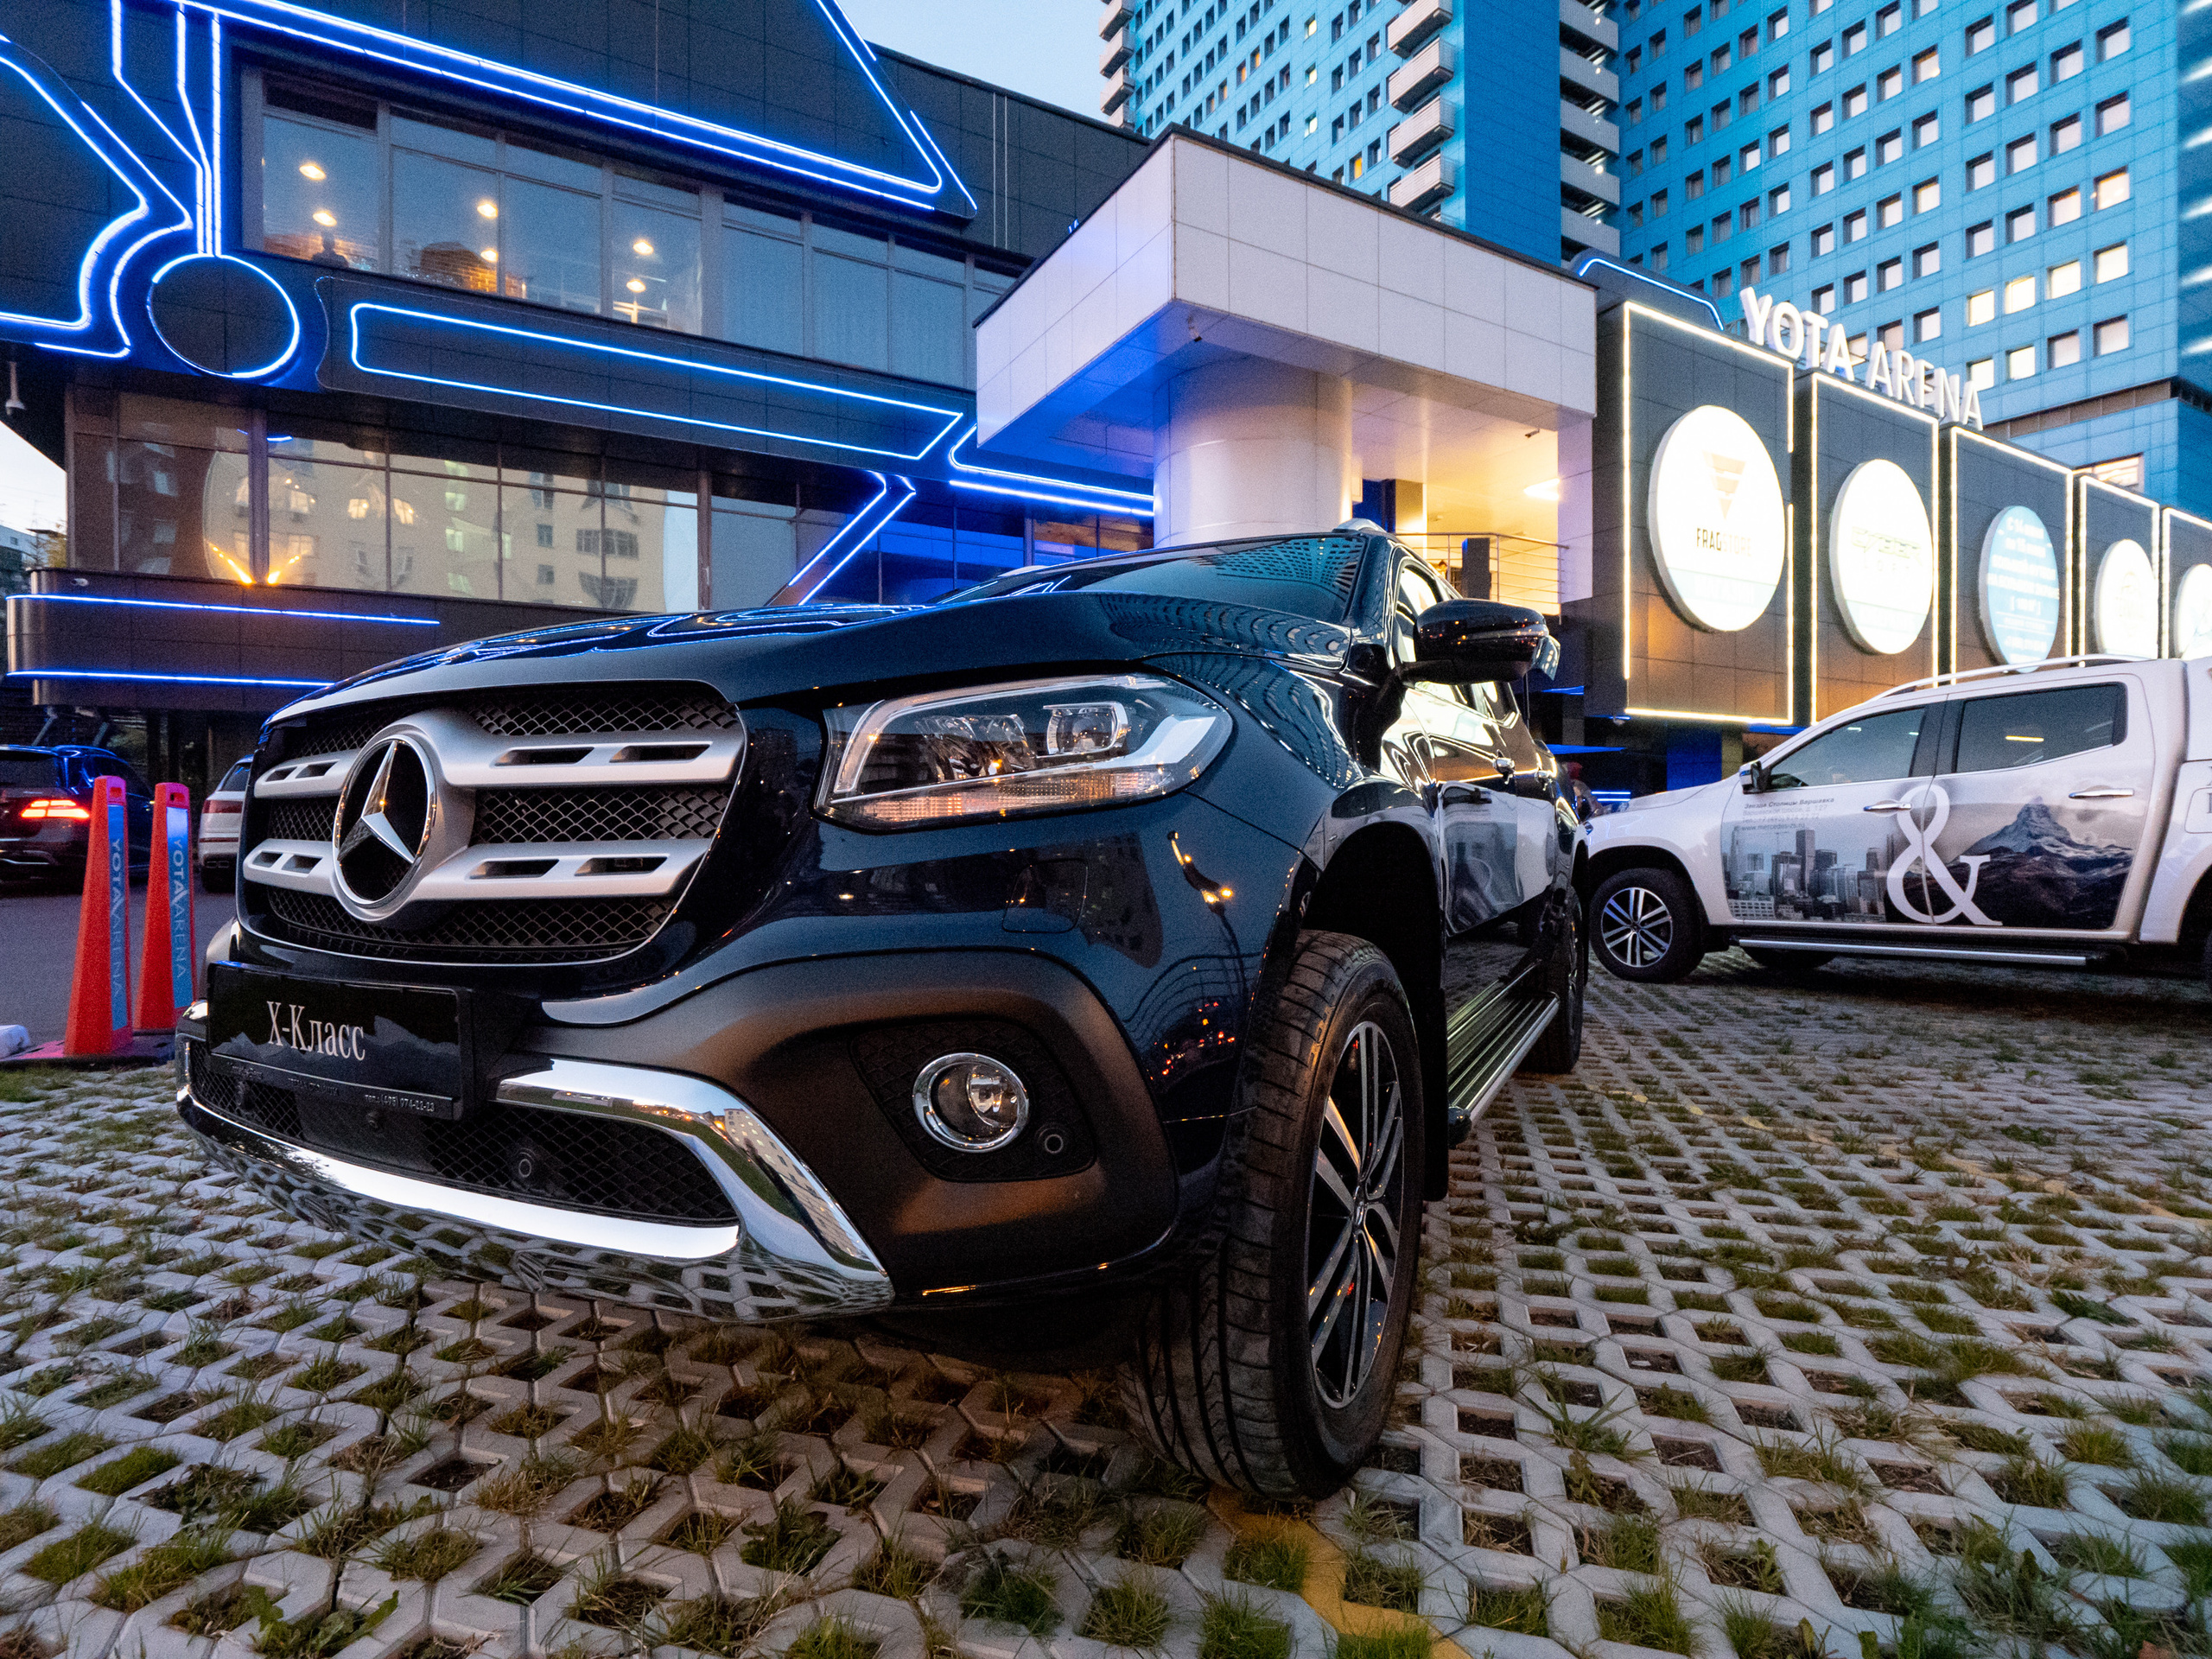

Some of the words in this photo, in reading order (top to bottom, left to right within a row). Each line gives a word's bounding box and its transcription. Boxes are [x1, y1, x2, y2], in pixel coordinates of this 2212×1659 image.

[1740, 287, 1854, 381] YOTA
[1866, 341, 1983, 430] ARENA
[1696, 526, 1752, 557] FRAGSTORE
[111, 838, 124, 904] YOTA
[173, 838, 186, 895] YOTA
[1886, 784, 2003, 926] &
[111, 913, 123, 996] ARENA
[173, 902, 187, 979] ARENA
[266, 1001, 365, 1061] X-Класс
